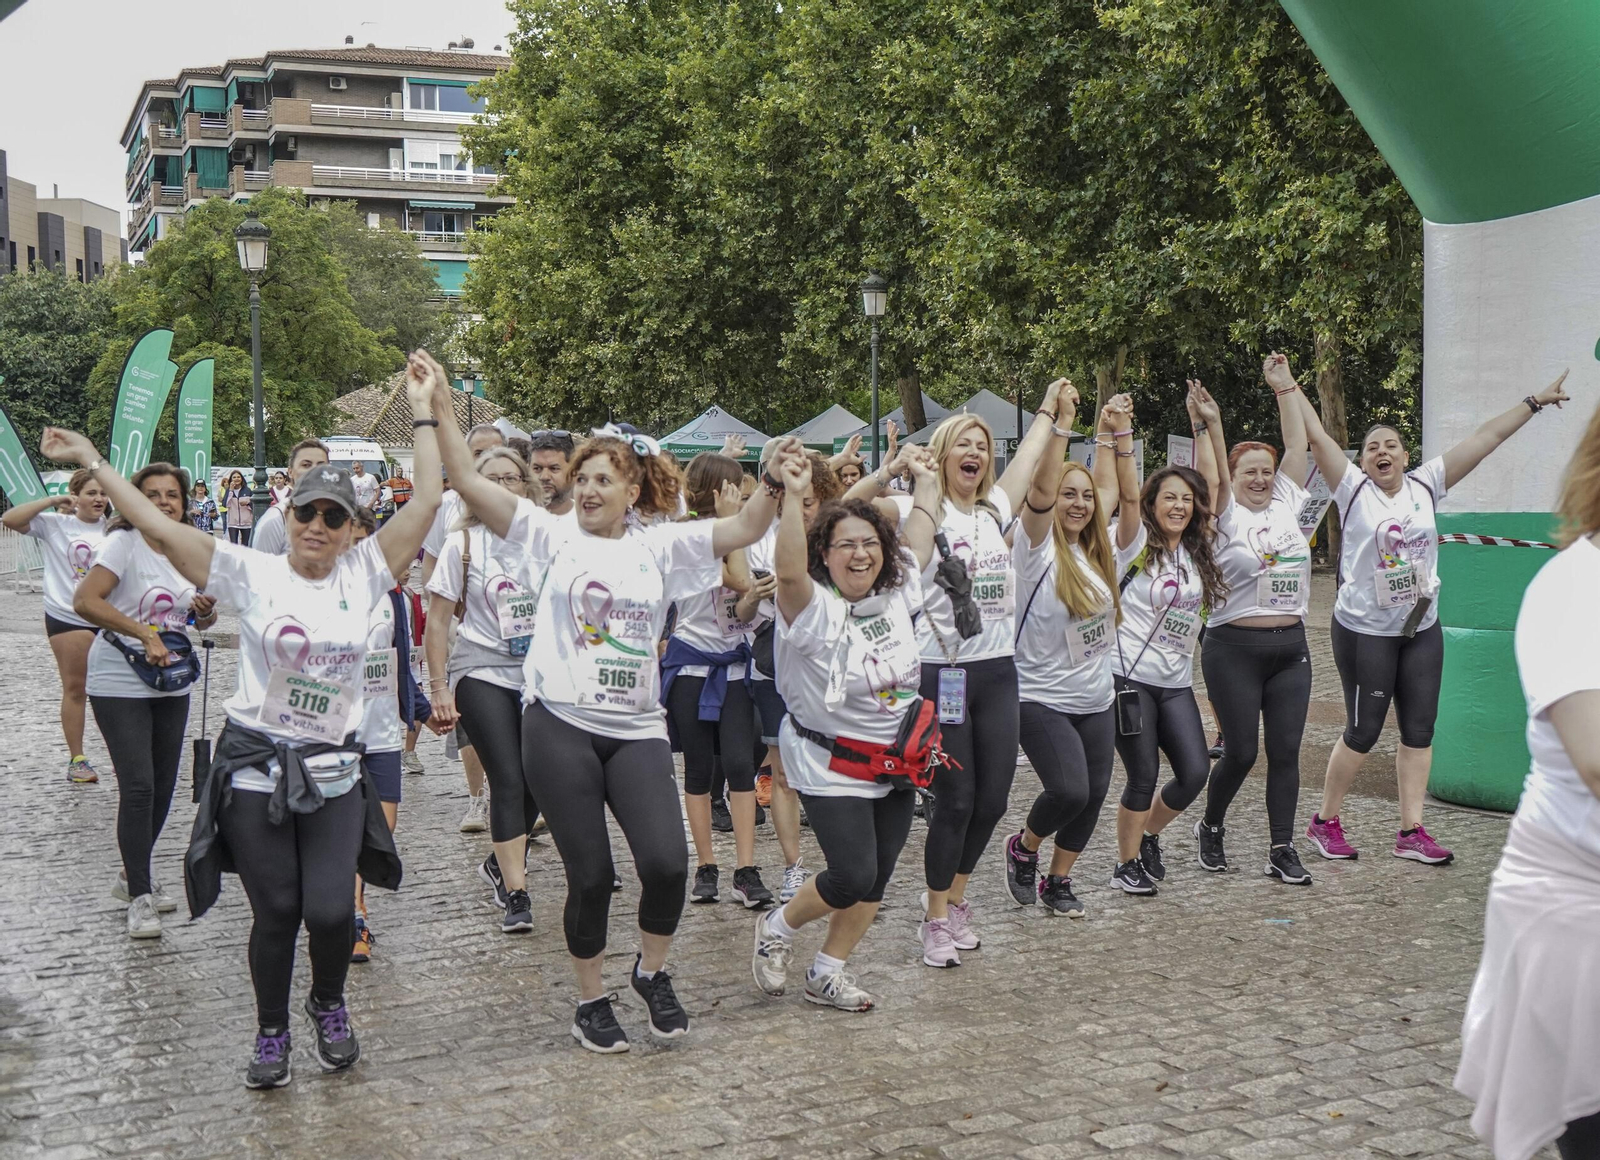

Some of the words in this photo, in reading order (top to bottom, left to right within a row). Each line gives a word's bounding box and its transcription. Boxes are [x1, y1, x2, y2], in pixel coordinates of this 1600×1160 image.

[128, 383, 154, 396] Tenemos
[125, 399, 146, 409] camino
[134, 394, 148, 402] gran
[122, 412, 144, 424] delante
[1272, 580, 1298, 593] 5248
[1388, 575, 1417, 592] 3654
[973, 584, 1005, 600] 4985
[507, 595, 533, 604] COVIR
[511, 602, 536, 618] 299
[609, 610, 653, 622] corazo
[1166, 609, 1195, 623] COVIRAN
[624, 622, 648, 632] 5415
[861, 618, 891, 641] 5166
[1077, 614, 1107, 632] COVIRAN
[1164, 618, 1190, 637] 5222
[1083, 623, 1105, 645] 5241
[880, 640, 901, 653] vithas
[1167, 640, 1186, 649] vithas
[594, 658, 642, 669] COVIRAN
[326, 666, 350, 677] 5415
[598, 668, 637, 689] 5165
[286, 677, 340, 695] COVIRAN
[288, 689, 330, 714] 5118
[608, 696, 636, 706] vithas
[293, 719, 326, 733] vithas
